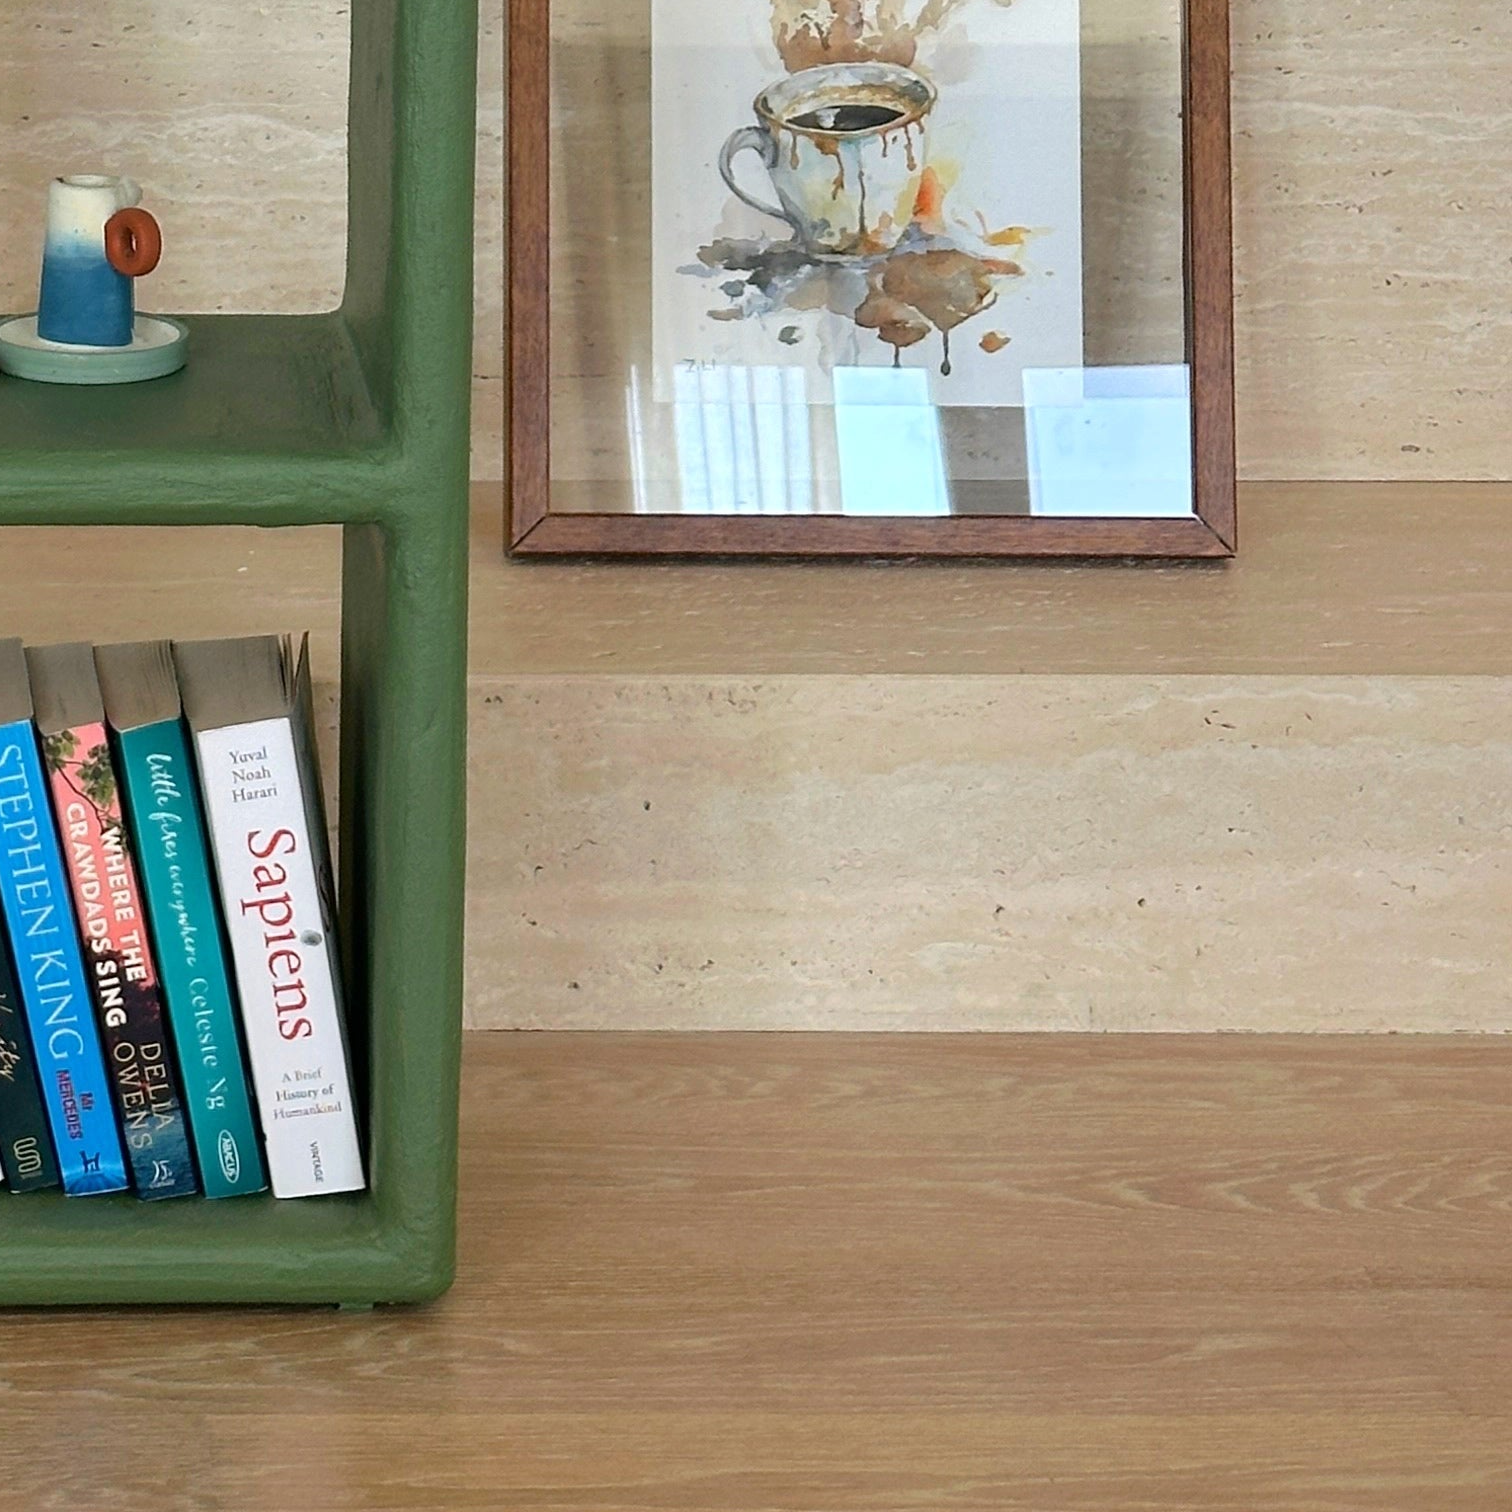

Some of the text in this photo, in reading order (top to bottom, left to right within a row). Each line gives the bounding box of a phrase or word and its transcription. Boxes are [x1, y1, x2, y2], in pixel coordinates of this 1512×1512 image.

[229, 746, 268, 765] Yuval
[232, 765, 271, 784] Noah
[232, 785, 278, 803] Harari
[66, 802, 127, 1028] CRAWDADS SING
[101, 826, 147, 983] WHERE THE
[240, 828, 314, 1041] Sapiens
[148, 811, 183, 858] fires
[168, 865, 198, 968] everywhere
[188, 977, 218, 1068] Celeste
[206, 1076, 227, 1110] Ng
[30, 949, 84, 1061] KING
[113, 1042, 153, 1150] OWENS
[139, 1042, 175, 1131] DELIA
[276, 1083, 335, 1102] History of
[282, 1067, 322, 1083] A Brief
[273, 1101, 342, 1120] Humankind
[310, 1141, 324, 1183] VINTAGE
